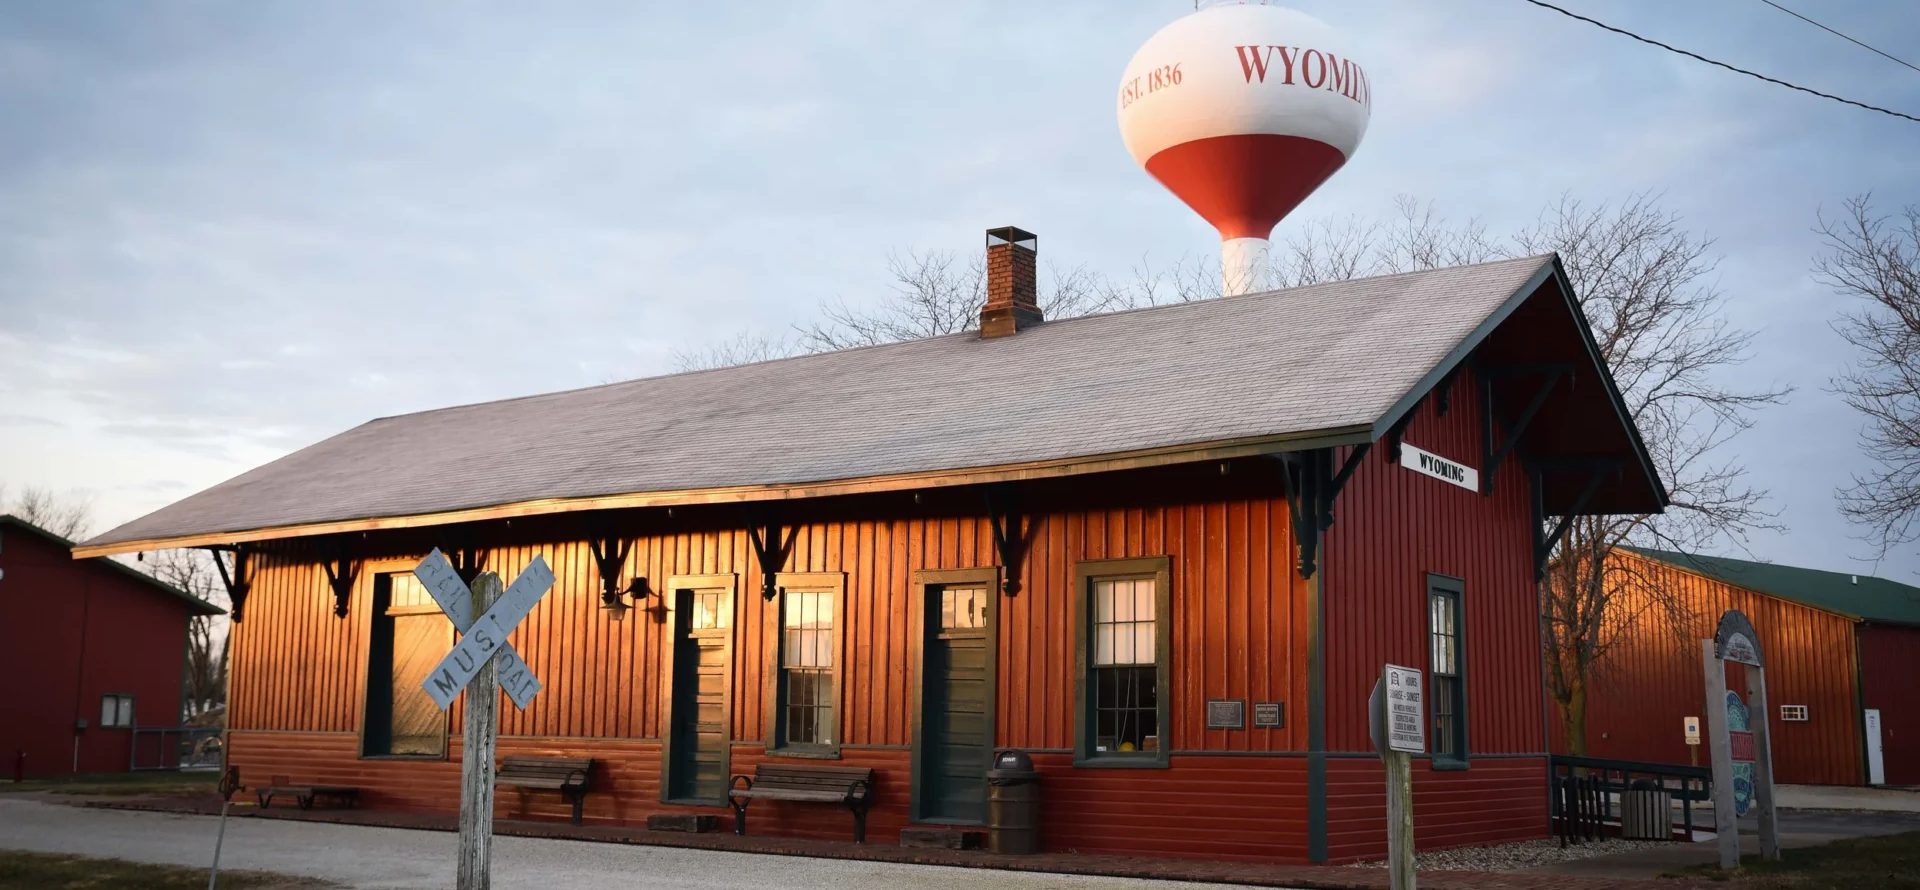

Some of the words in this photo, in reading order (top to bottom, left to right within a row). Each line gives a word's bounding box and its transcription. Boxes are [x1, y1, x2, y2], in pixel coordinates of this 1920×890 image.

[1121, 77, 1143, 109] EST.
[1149, 62, 1182, 94] 1836
[1234, 45, 1371, 117] WYOMIN
[1419, 452, 1464, 482] WYOMING
